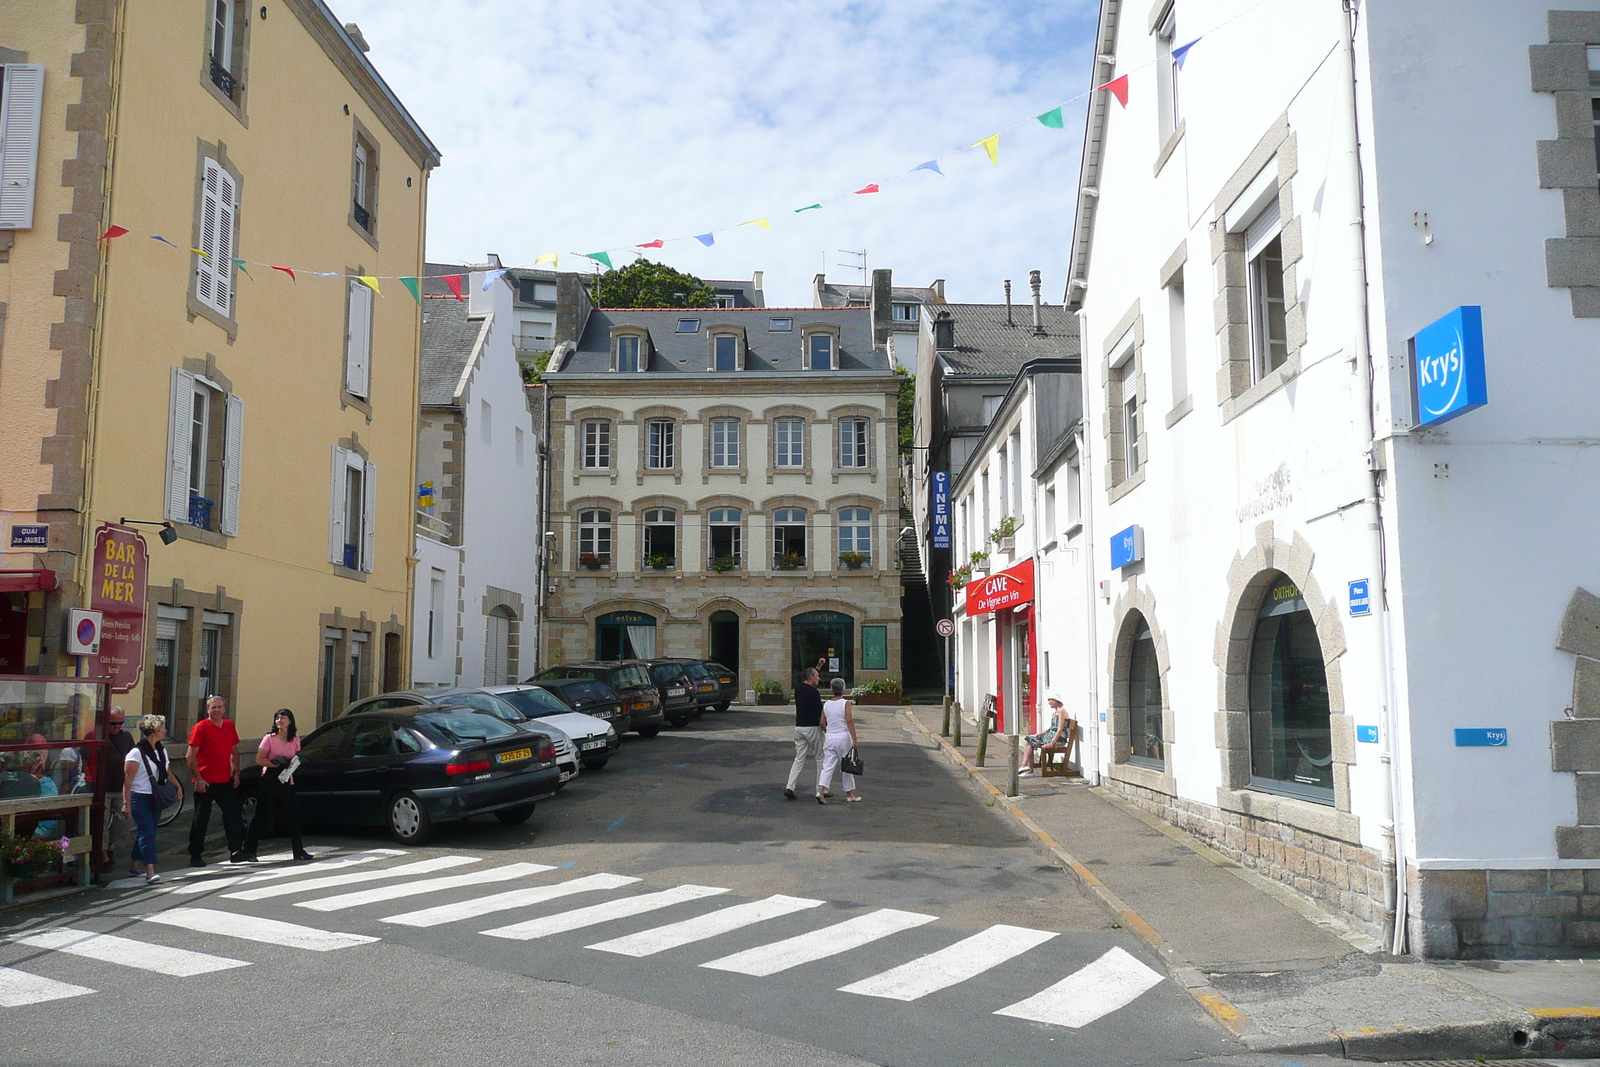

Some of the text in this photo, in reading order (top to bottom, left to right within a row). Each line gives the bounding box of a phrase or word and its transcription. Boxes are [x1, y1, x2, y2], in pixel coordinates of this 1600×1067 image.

[1420, 348, 1459, 388] Krys
[935, 472, 948, 535] CINEMA
[105, 539, 136, 565] BAR
[104, 563, 135, 580] DE LA
[101, 579, 135, 604] MER
[985, 577, 1008, 596] CAVE
[978, 590, 1020, 610] De Vigne en Vin
[1486, 731, 1504, 740] Krys
